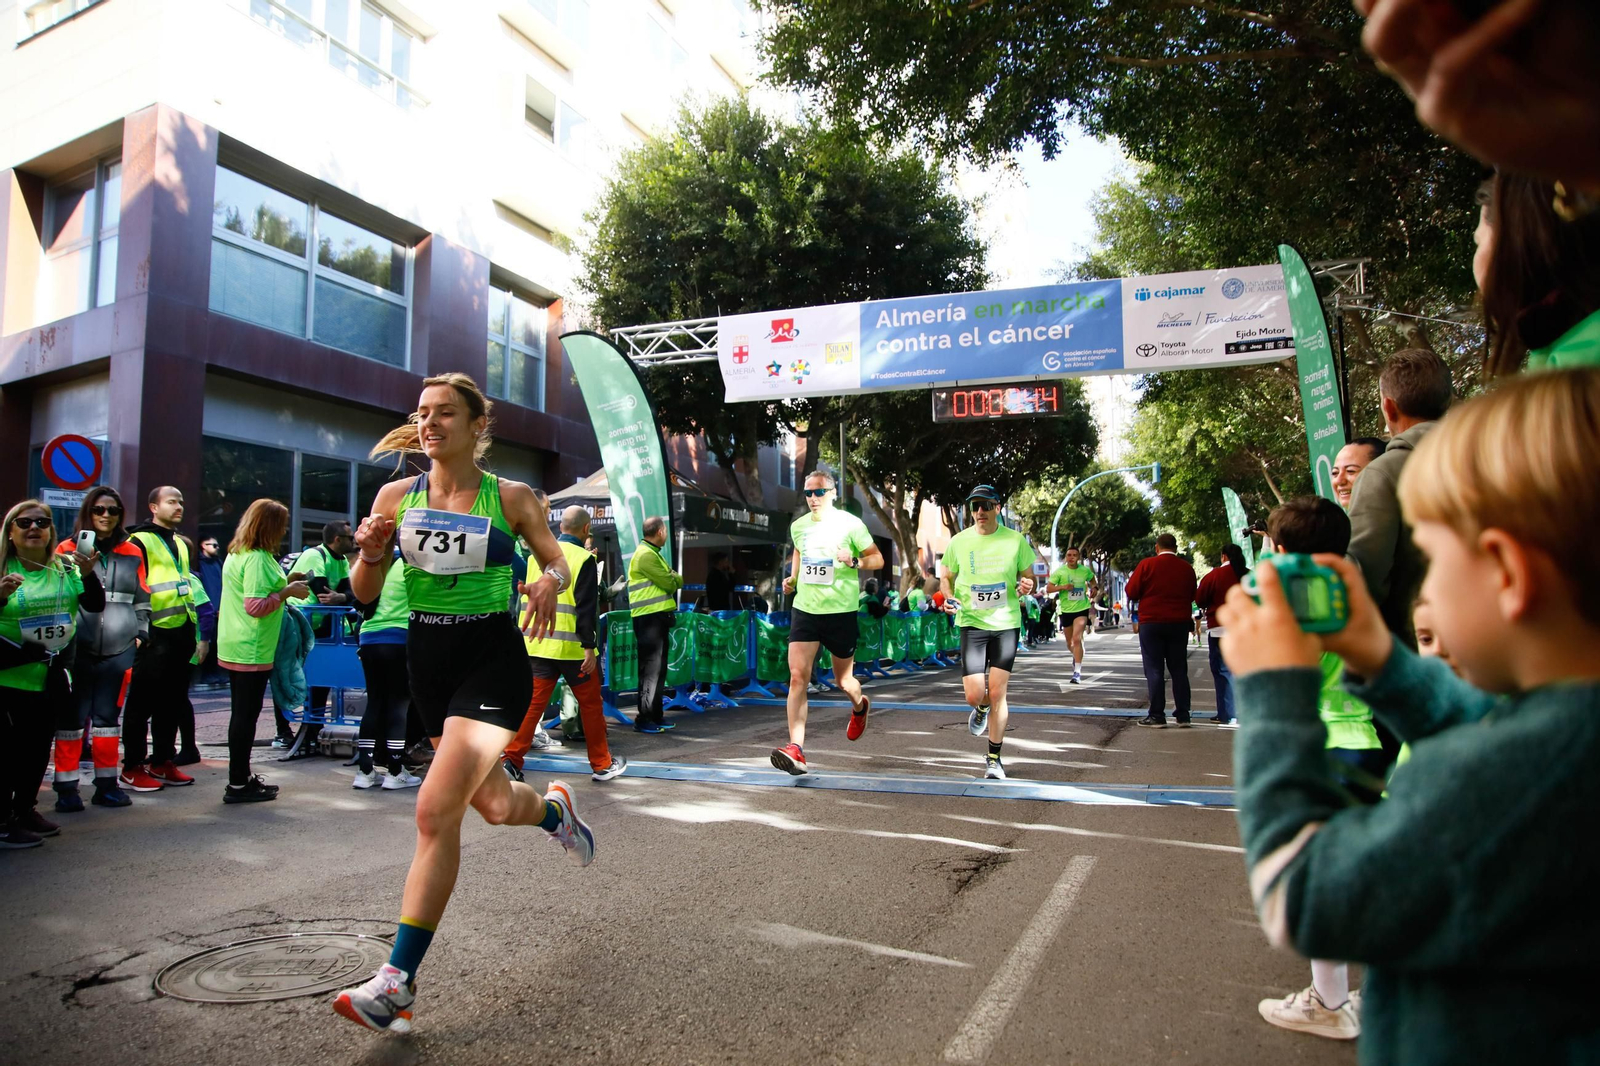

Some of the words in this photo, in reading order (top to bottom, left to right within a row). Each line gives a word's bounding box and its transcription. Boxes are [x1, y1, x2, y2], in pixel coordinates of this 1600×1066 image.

[1244, 279, 1285, 288] UNIVERSIDA
[1256, 285, 1286, 293] ALMERI
[1154, 286, 1205, 300] cajamar
[876, 303, 966, 328] Almería
[974, 303, 1003, 318] en
[1011, 291, 1106, 316] marcha
[1205, 311, 1265, 325] Fundación
[1156, 321, 1192, 329] MICHELIN
[1236, 328, 1257, 339] Ejido
[1258, 327, 1286, 336] Motor
[876, 332, 951, 355] contra
[958, 327, 982, 347] el
[988, 323, 1074, 345] cáncer
[1160, 341, 1186, 349] Toyota
[1160, 347, 1189, 356] Alborán
[1191, 347, 1214, 355] Motor
[725, 366, 756, 377] ALMERÍA
[870, 369, 946, 380] #TodosContraElCáncer
[415, 529, 467, 555] 731
[805, 565, 827, 576] 315
[977, 591, 1001, 602] 573
[419, 613, 454, 625] NIKE
[33, 625, 66, 641] 153
